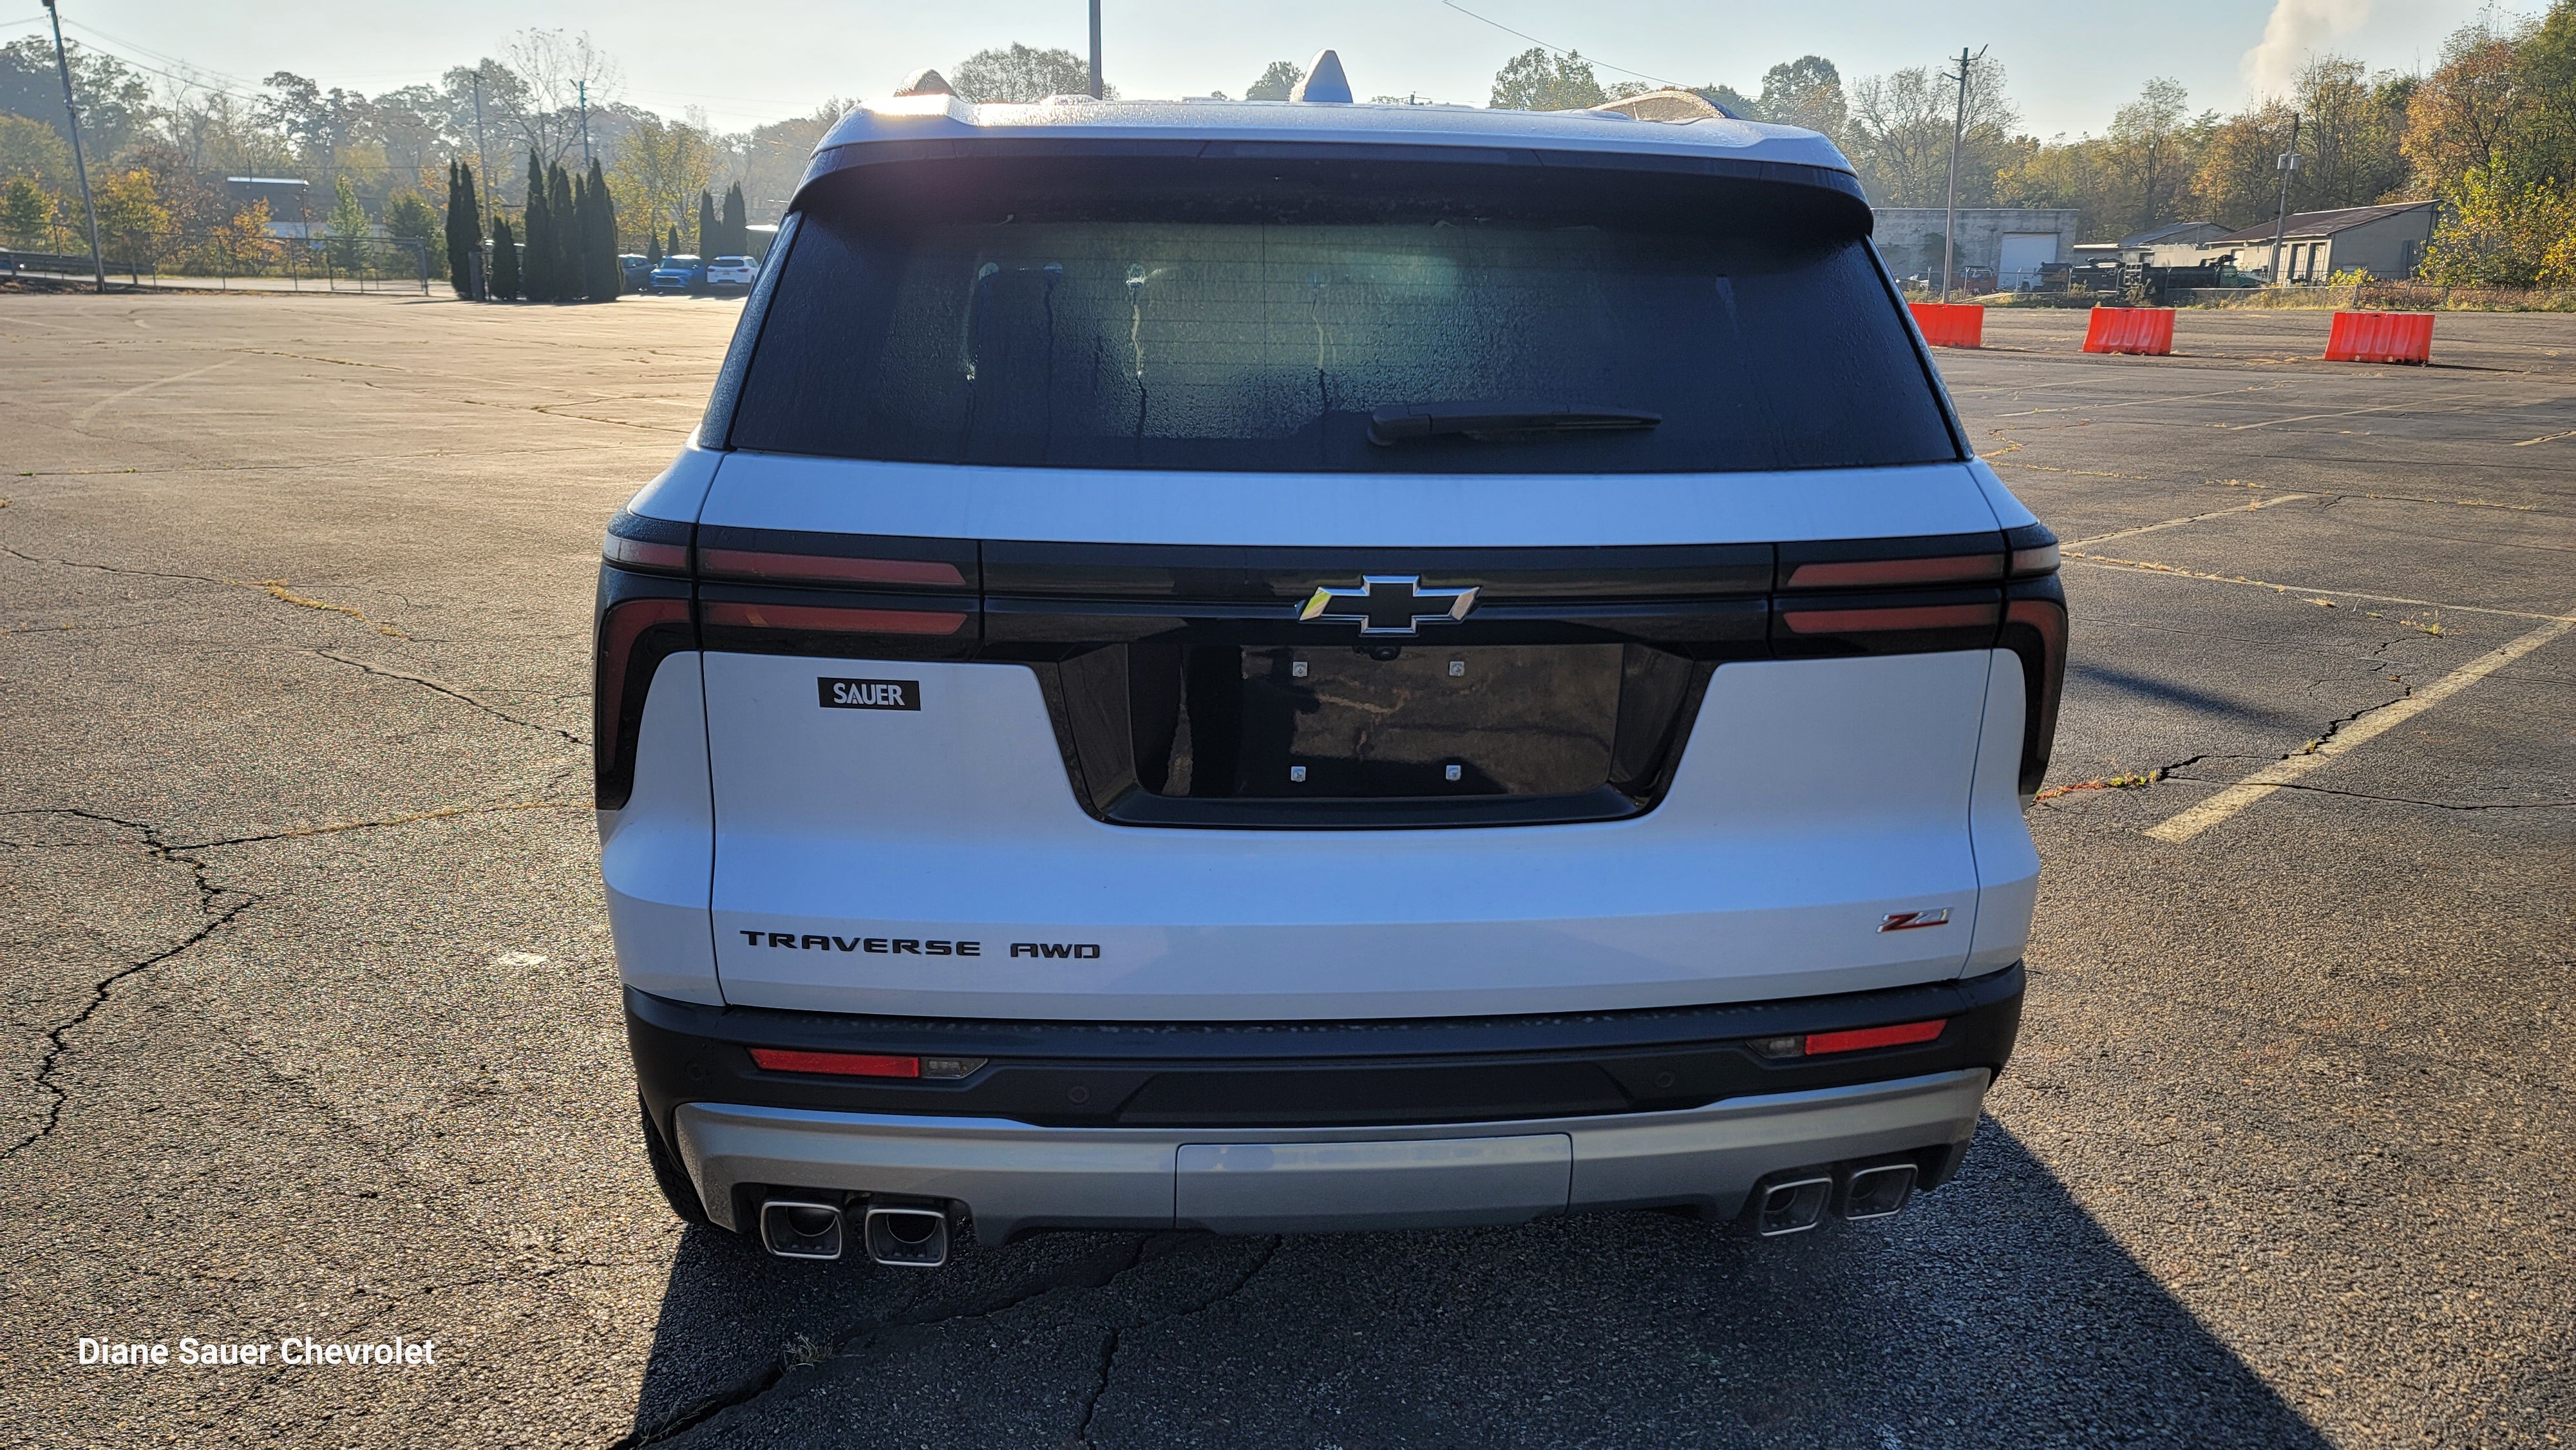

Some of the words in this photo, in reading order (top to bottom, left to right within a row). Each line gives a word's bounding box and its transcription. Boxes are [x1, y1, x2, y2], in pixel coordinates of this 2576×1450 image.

[833, 683, 905, 706] SAUER
[739, 930, 981, 957] TRAVERSE
[1010, 943, 1101, 959] AWD
